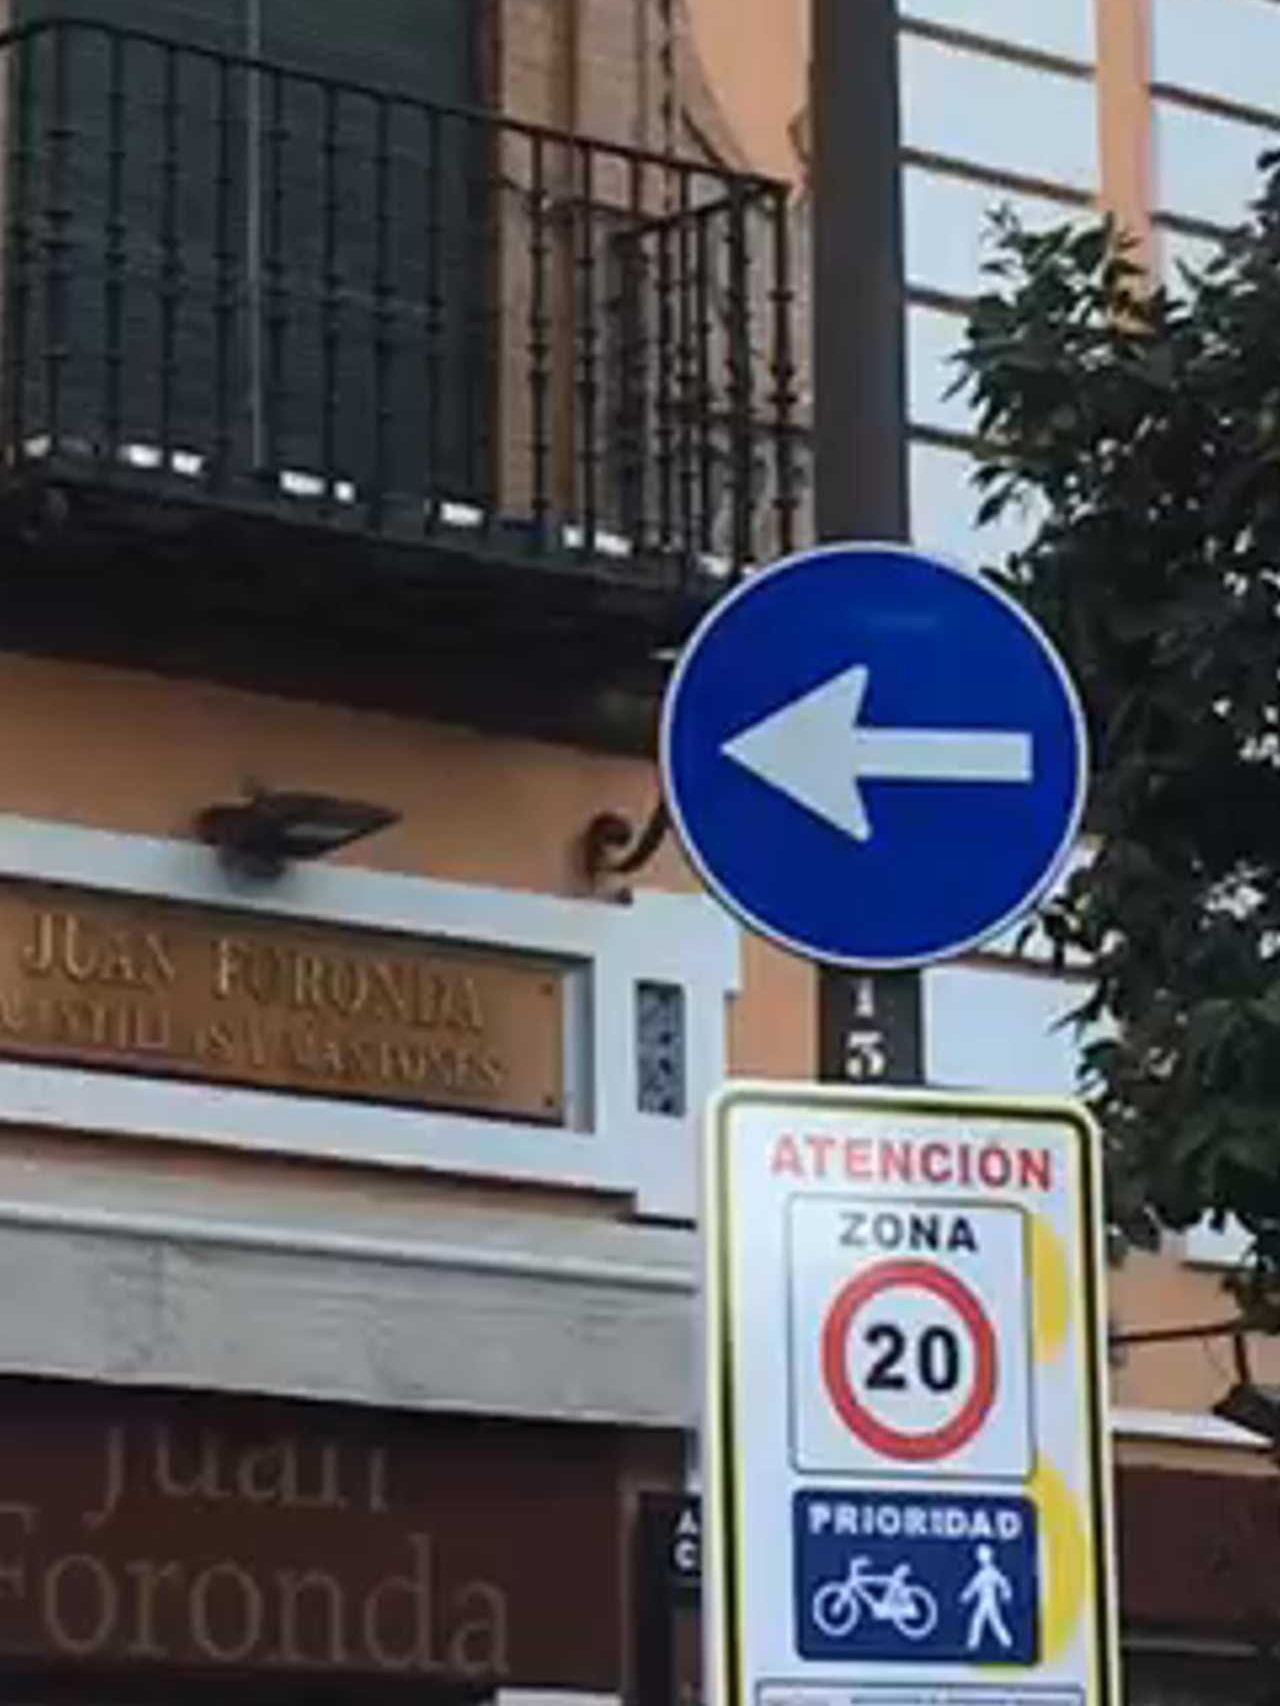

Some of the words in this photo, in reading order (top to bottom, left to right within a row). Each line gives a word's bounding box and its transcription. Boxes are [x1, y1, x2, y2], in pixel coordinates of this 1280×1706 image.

[23, 911, 177, 982] JUAN
[214, 938, 486, 1033] FORONDA
[838, 1211, 979, 1253] ZONA
[862, 1323, 962, 1394] 20
[807, 1501, 1022, 1540] PRIORIDAD
